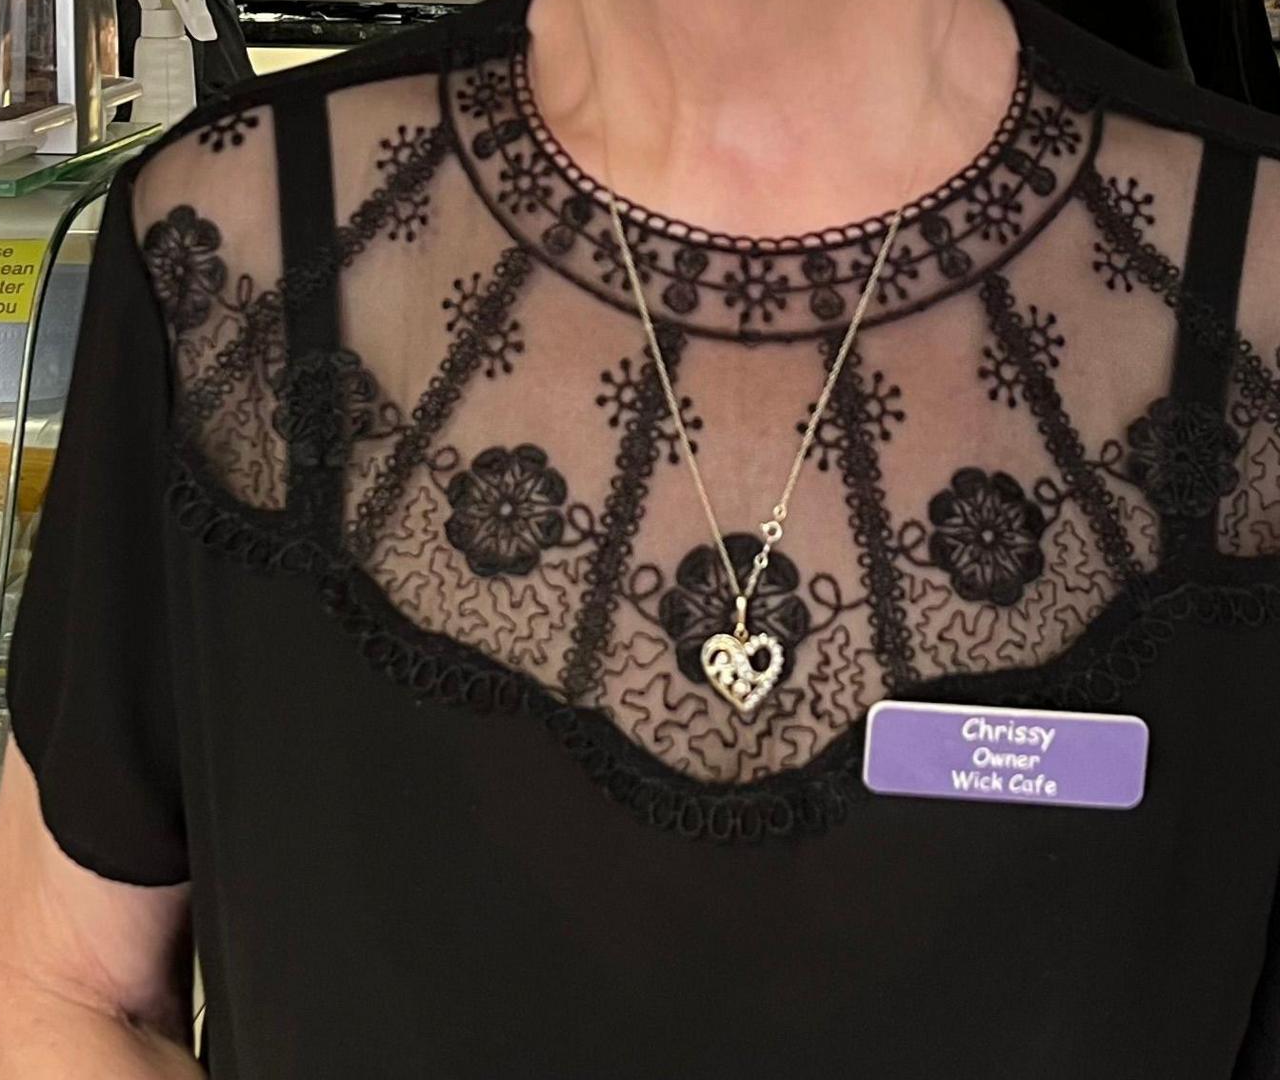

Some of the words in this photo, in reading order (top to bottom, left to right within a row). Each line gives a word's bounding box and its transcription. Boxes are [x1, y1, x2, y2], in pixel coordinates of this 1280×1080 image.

[962, 717, 1056, 751] Chrissy
[972, 747, 1041, 769] Owner
[951, 770, 1003, 792] Wick
[1008, 773, 1058, 797] Cafe
